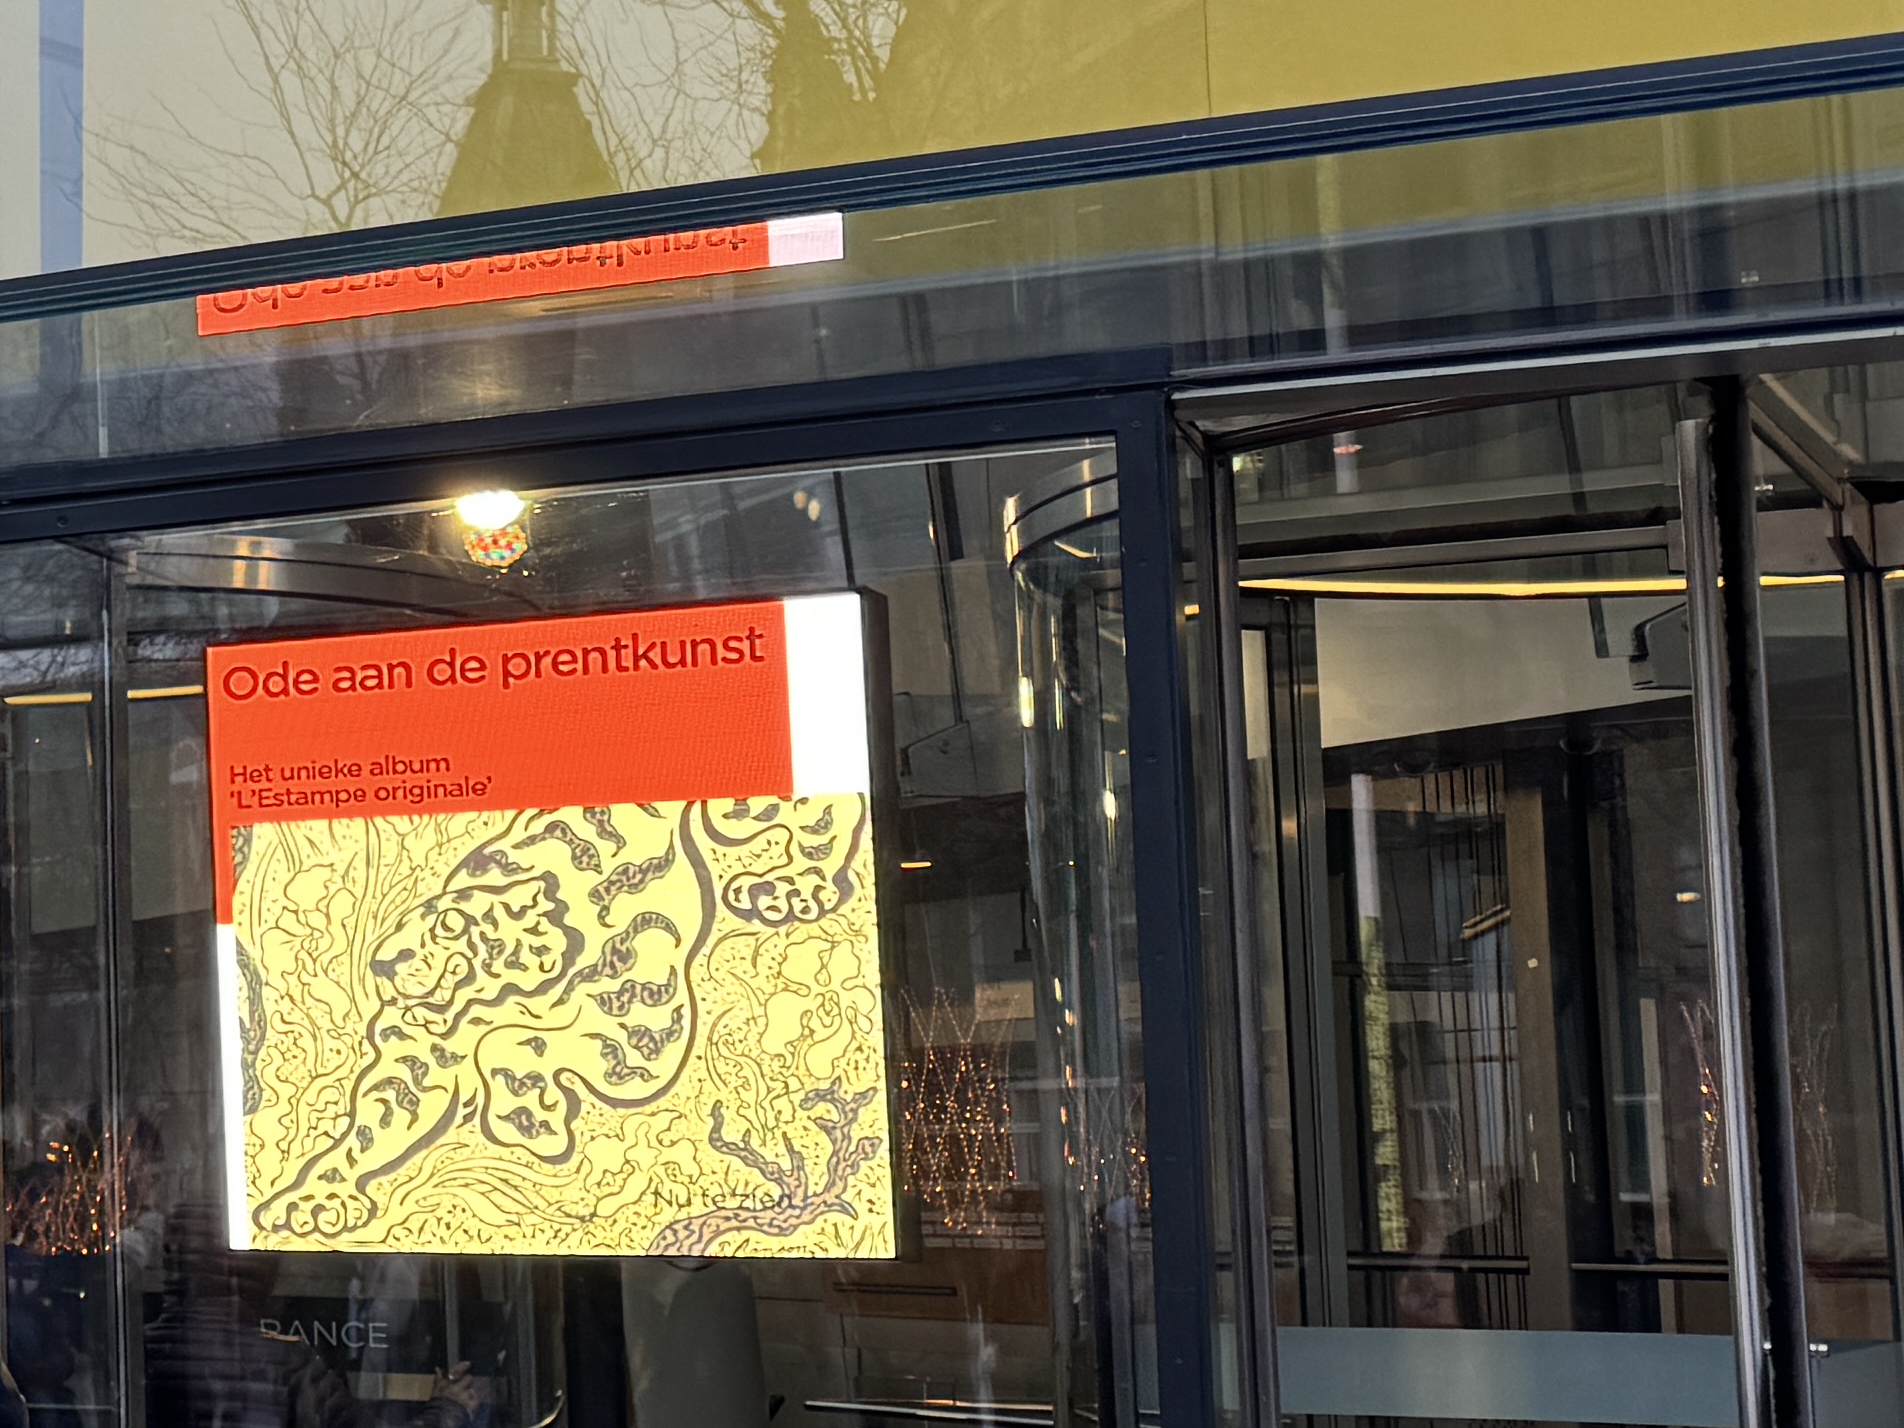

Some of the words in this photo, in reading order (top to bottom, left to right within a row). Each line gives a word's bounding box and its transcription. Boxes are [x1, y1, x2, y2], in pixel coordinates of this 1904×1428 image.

[223, 659, 320, 701] Ode
[332, 660, 414, 693] aan
[426, 647, 488, 687] de
[501, 626, 766, 690] prentkunst
[229, 764, 274, 785] Het
[280, 758, 363, 782] unieke
[369, 754, 451, 778] album
[651, 1188, 692, 1208] Nu
[703, 1187, 726, 1208] te
